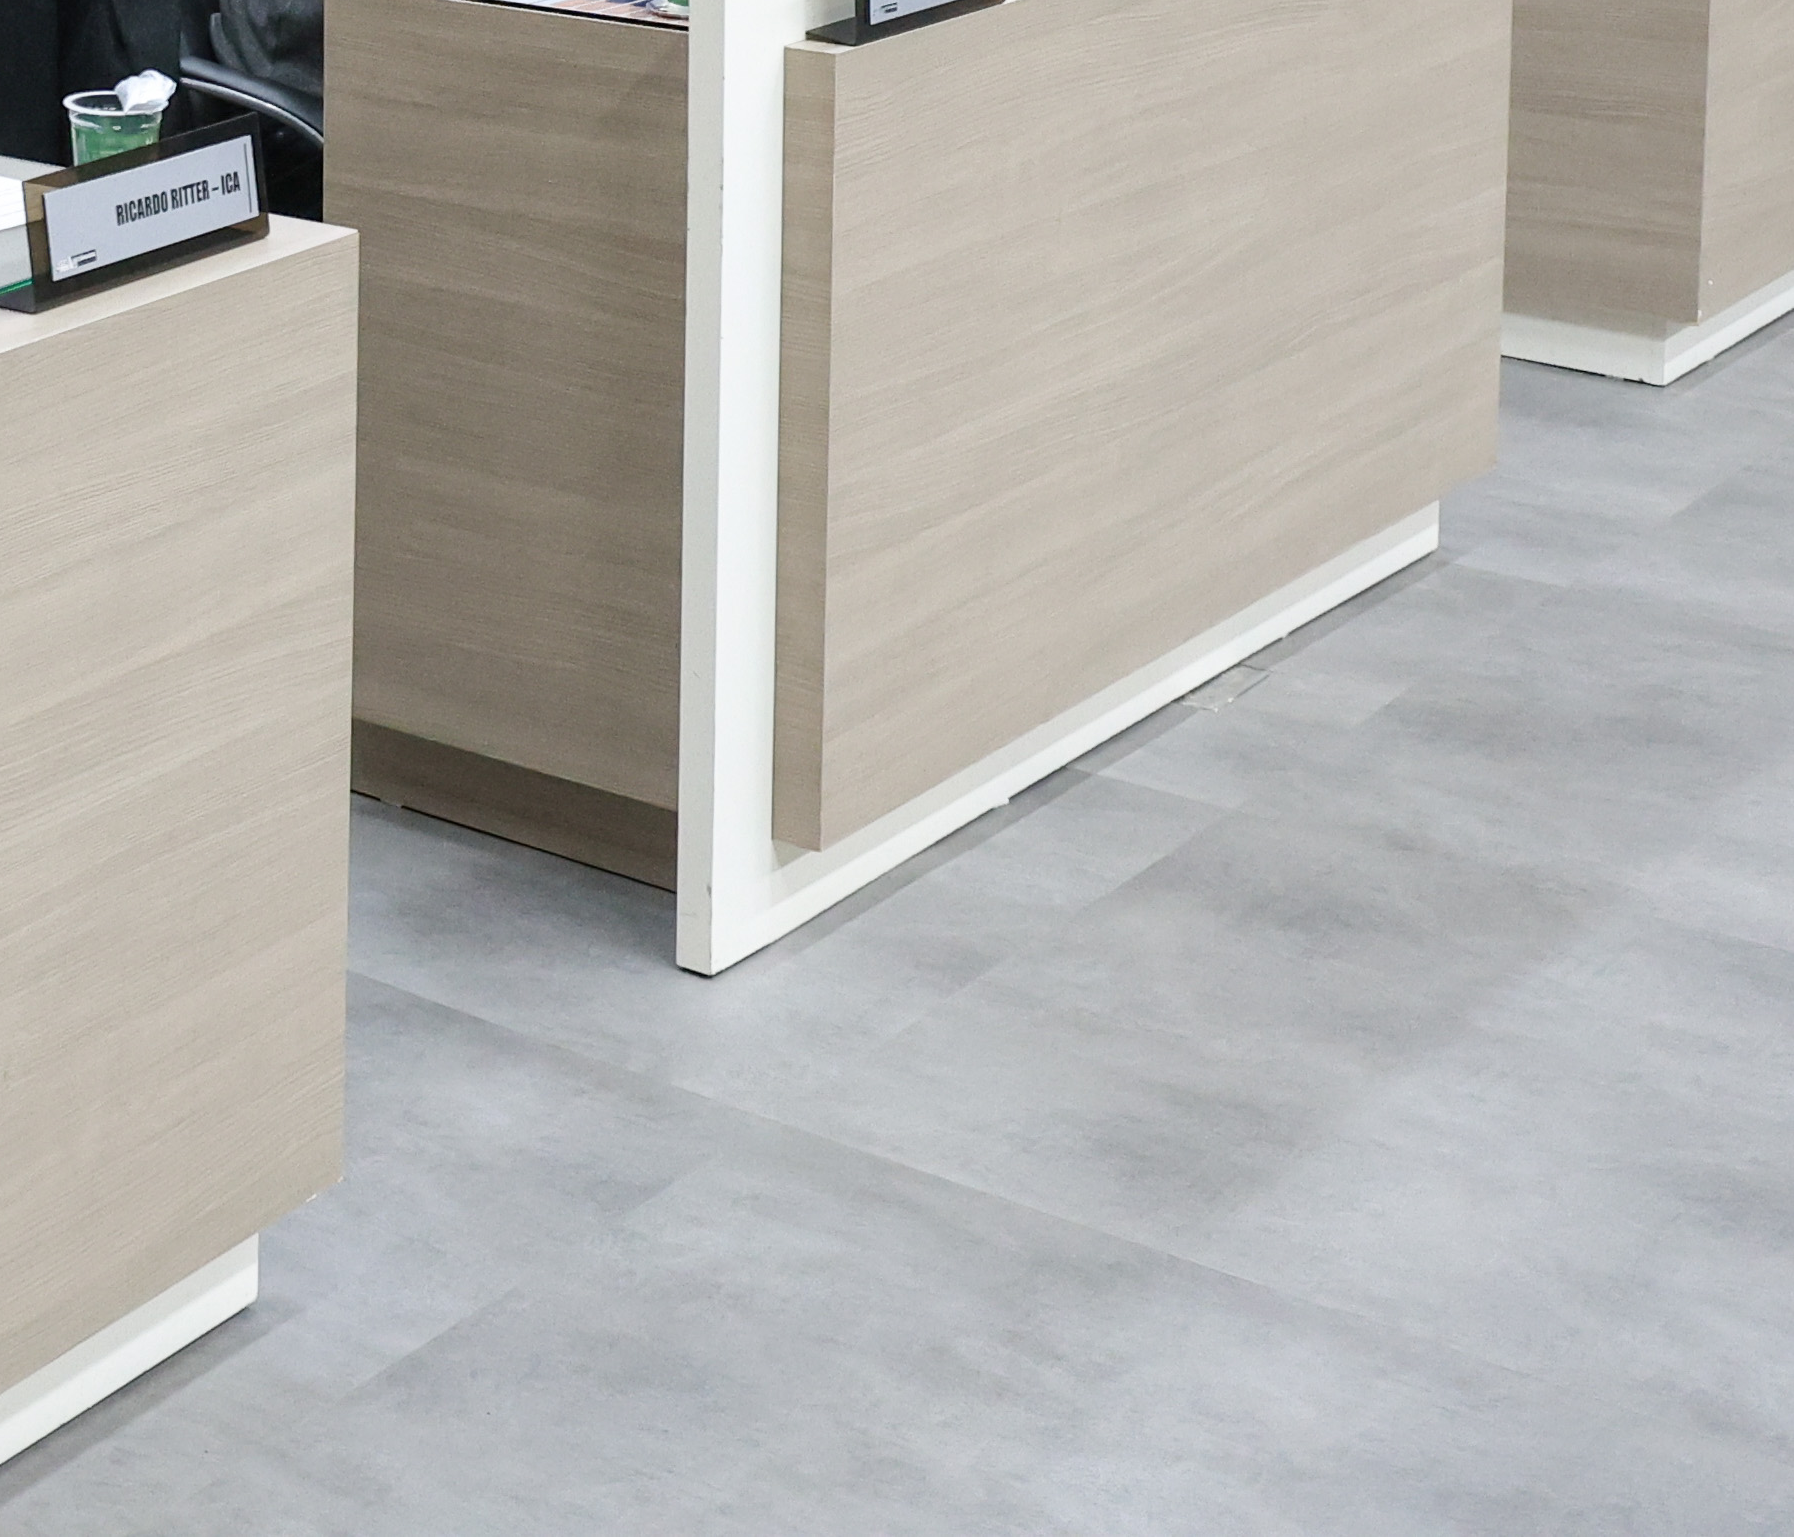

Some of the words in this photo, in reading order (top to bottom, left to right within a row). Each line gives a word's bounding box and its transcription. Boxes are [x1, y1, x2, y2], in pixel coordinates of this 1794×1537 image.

[115, 194, 169, 226] RICARDO
[170, 180, 210, 210] RITTER
[221, 171, 241, 196] ICA
